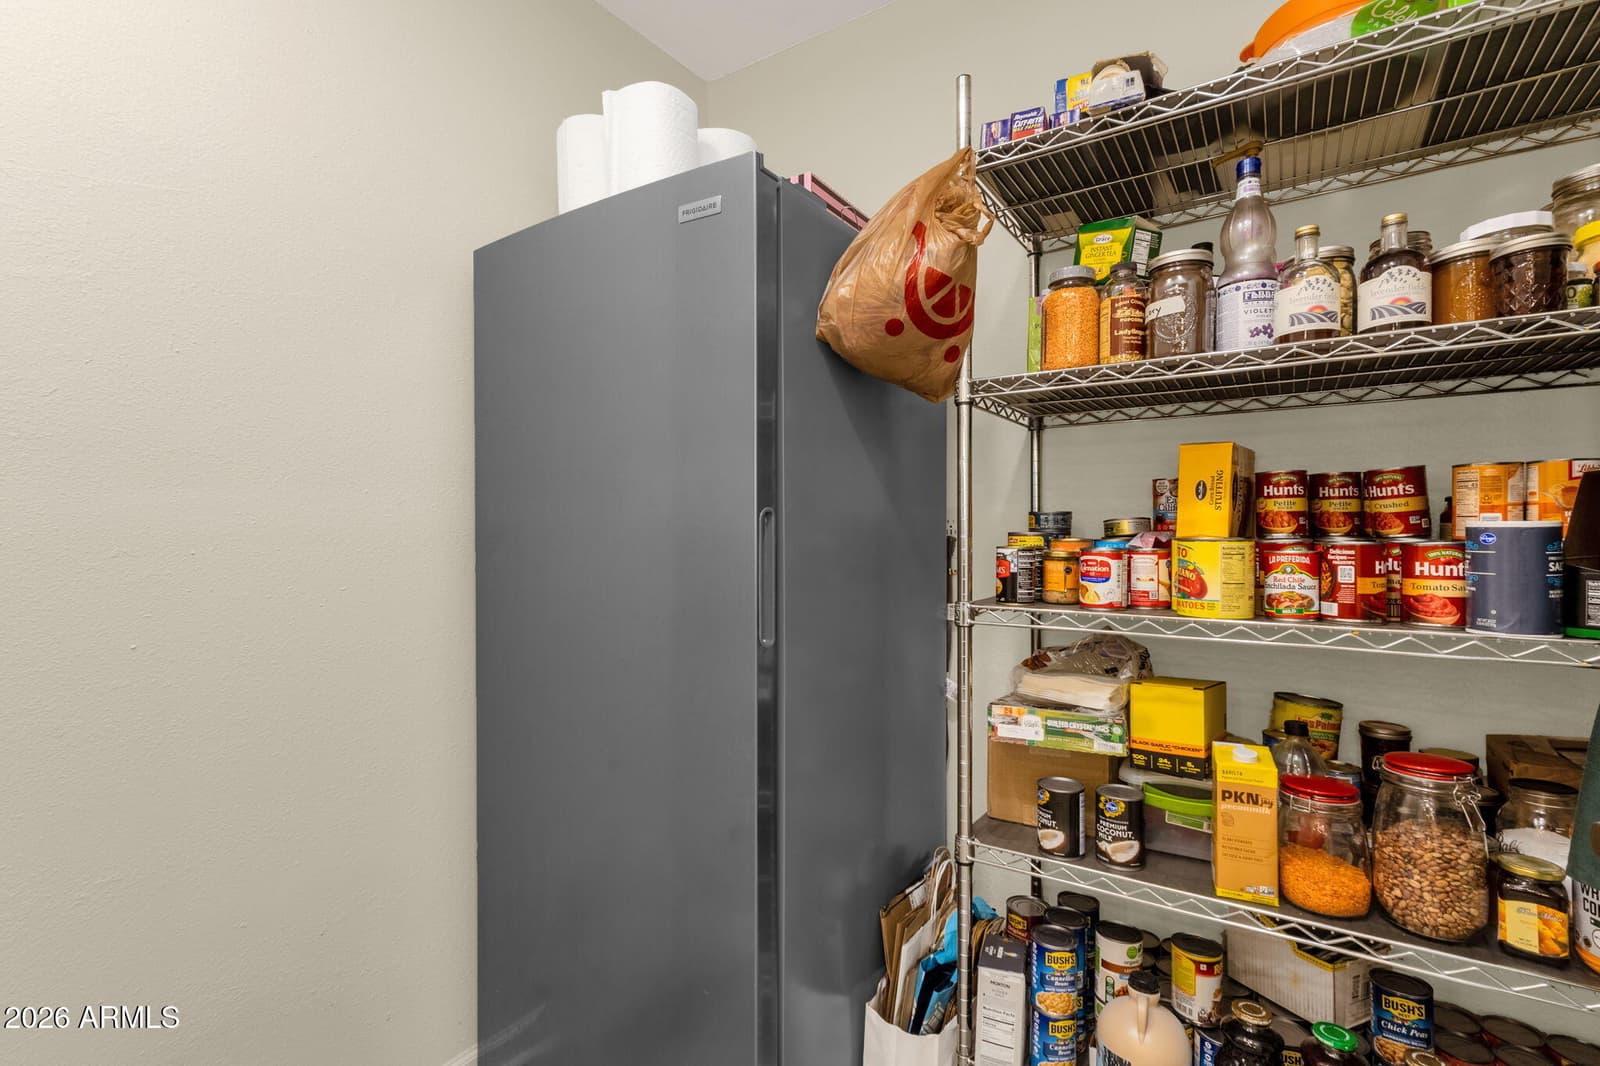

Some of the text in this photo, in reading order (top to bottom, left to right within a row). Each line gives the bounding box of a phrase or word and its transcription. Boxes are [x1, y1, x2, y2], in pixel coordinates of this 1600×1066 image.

[682, 202, 717, 216] FRIGIDAIRE
[1215, 469, 1225, 511] STUFFING
[1374, 501, 1410, 509] Crushed
[1269, 555, 1310, 564] LA PREFERIDA
[1411, 583, 1449, 591] Tomato
[1221, 790, 1259, 806] PKN
[1100, 820, 1127, 831] PREMIUM
[1099, 832, 1112, 841] MILK
[1384, 997, 1424, 1017] BUSH'S
[1381, 1020, 1428, 1038] Chick Peas
